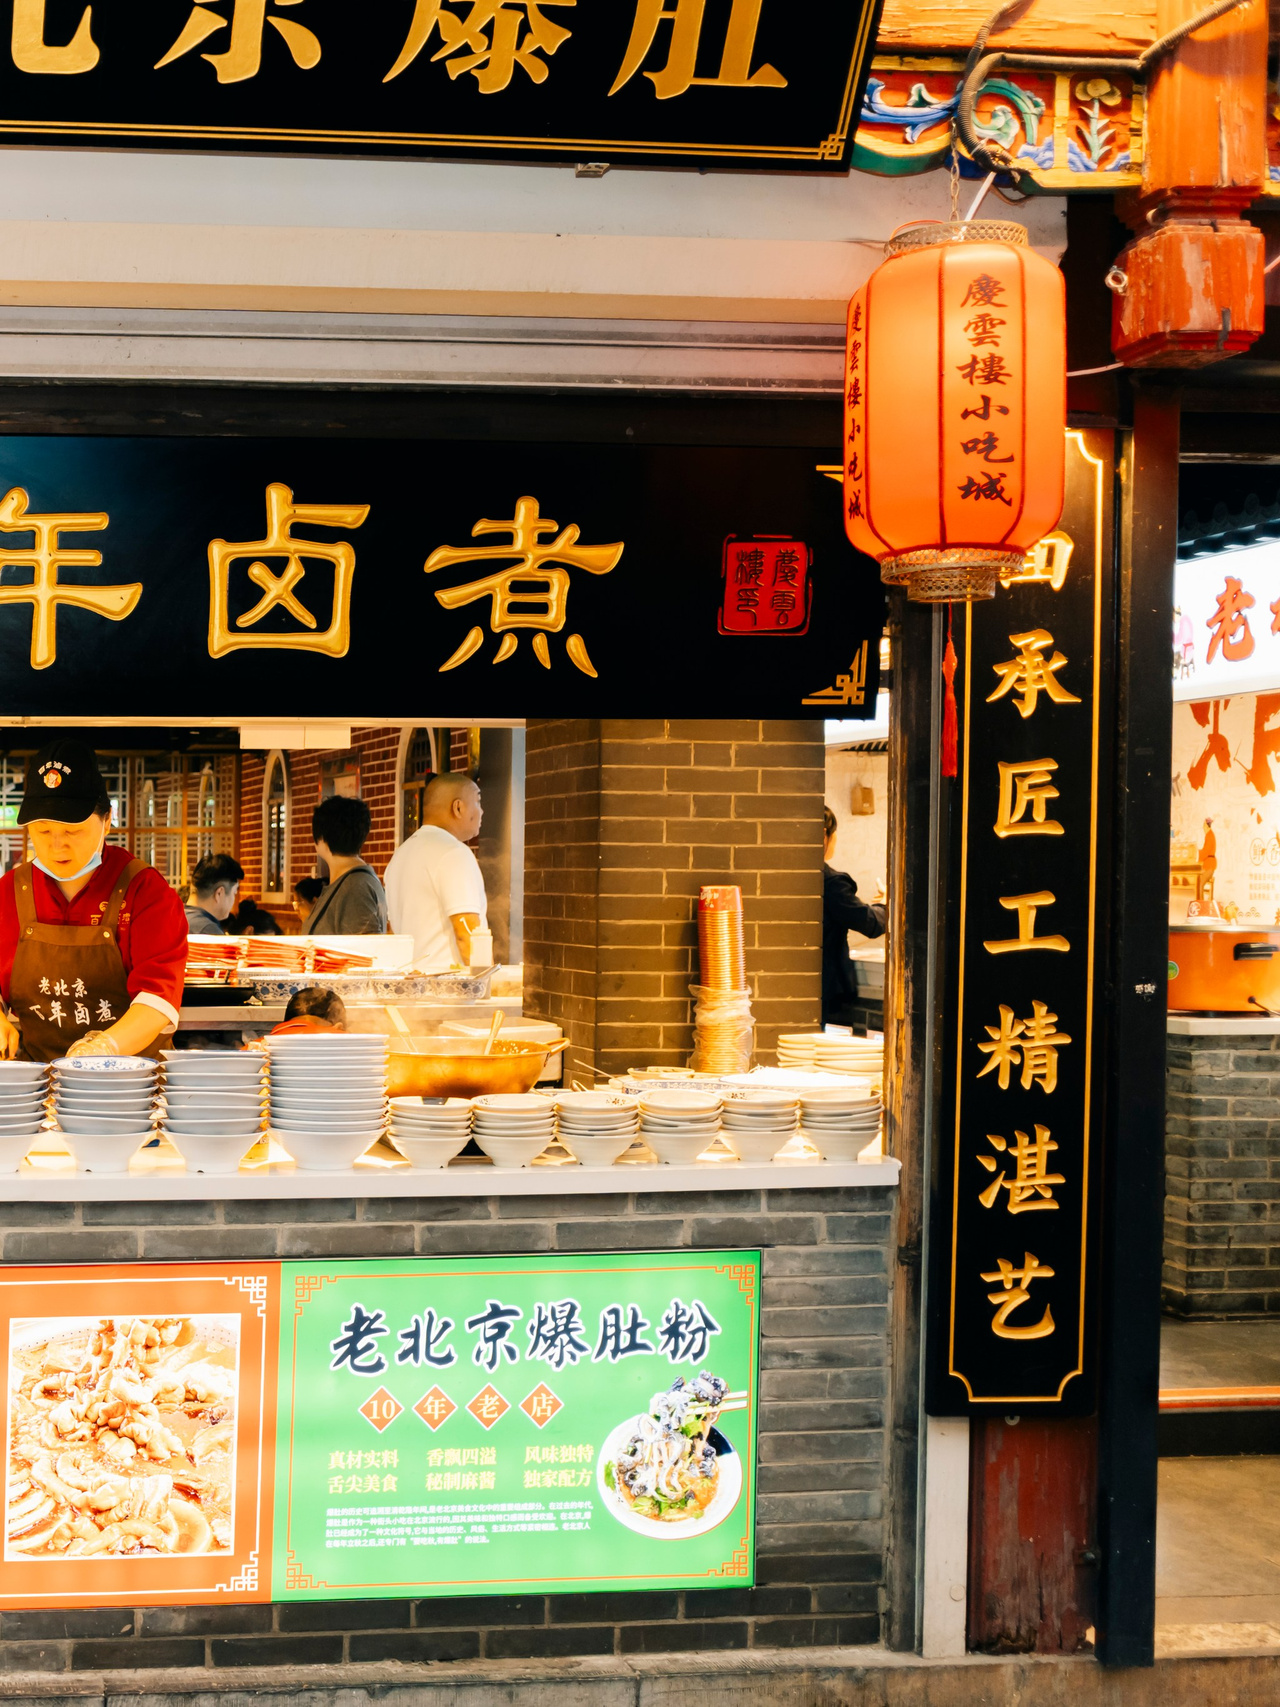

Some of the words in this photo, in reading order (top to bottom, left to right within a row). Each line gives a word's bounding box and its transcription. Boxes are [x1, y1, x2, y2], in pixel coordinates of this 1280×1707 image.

[956, 273, 1015, 507] 慶雲樓小吃城
[1206, 576, 1280, 664] 老
[38, 976, 88, 998] 老北京
[331, 1299, 721, 1374] 老北京爆肚粉
[327, 1474, 398, 1494] 舌尖美食
[425, 1471, 496, 1491] 秘制麻酱
[523, 1469, 593, 1489] 独家配方
[328, 1449, 399, 1470] 真材实料
[426, 1446, 497, 1467] 香飘四溢
[523, 1444, 594, 1465] 风味独特
